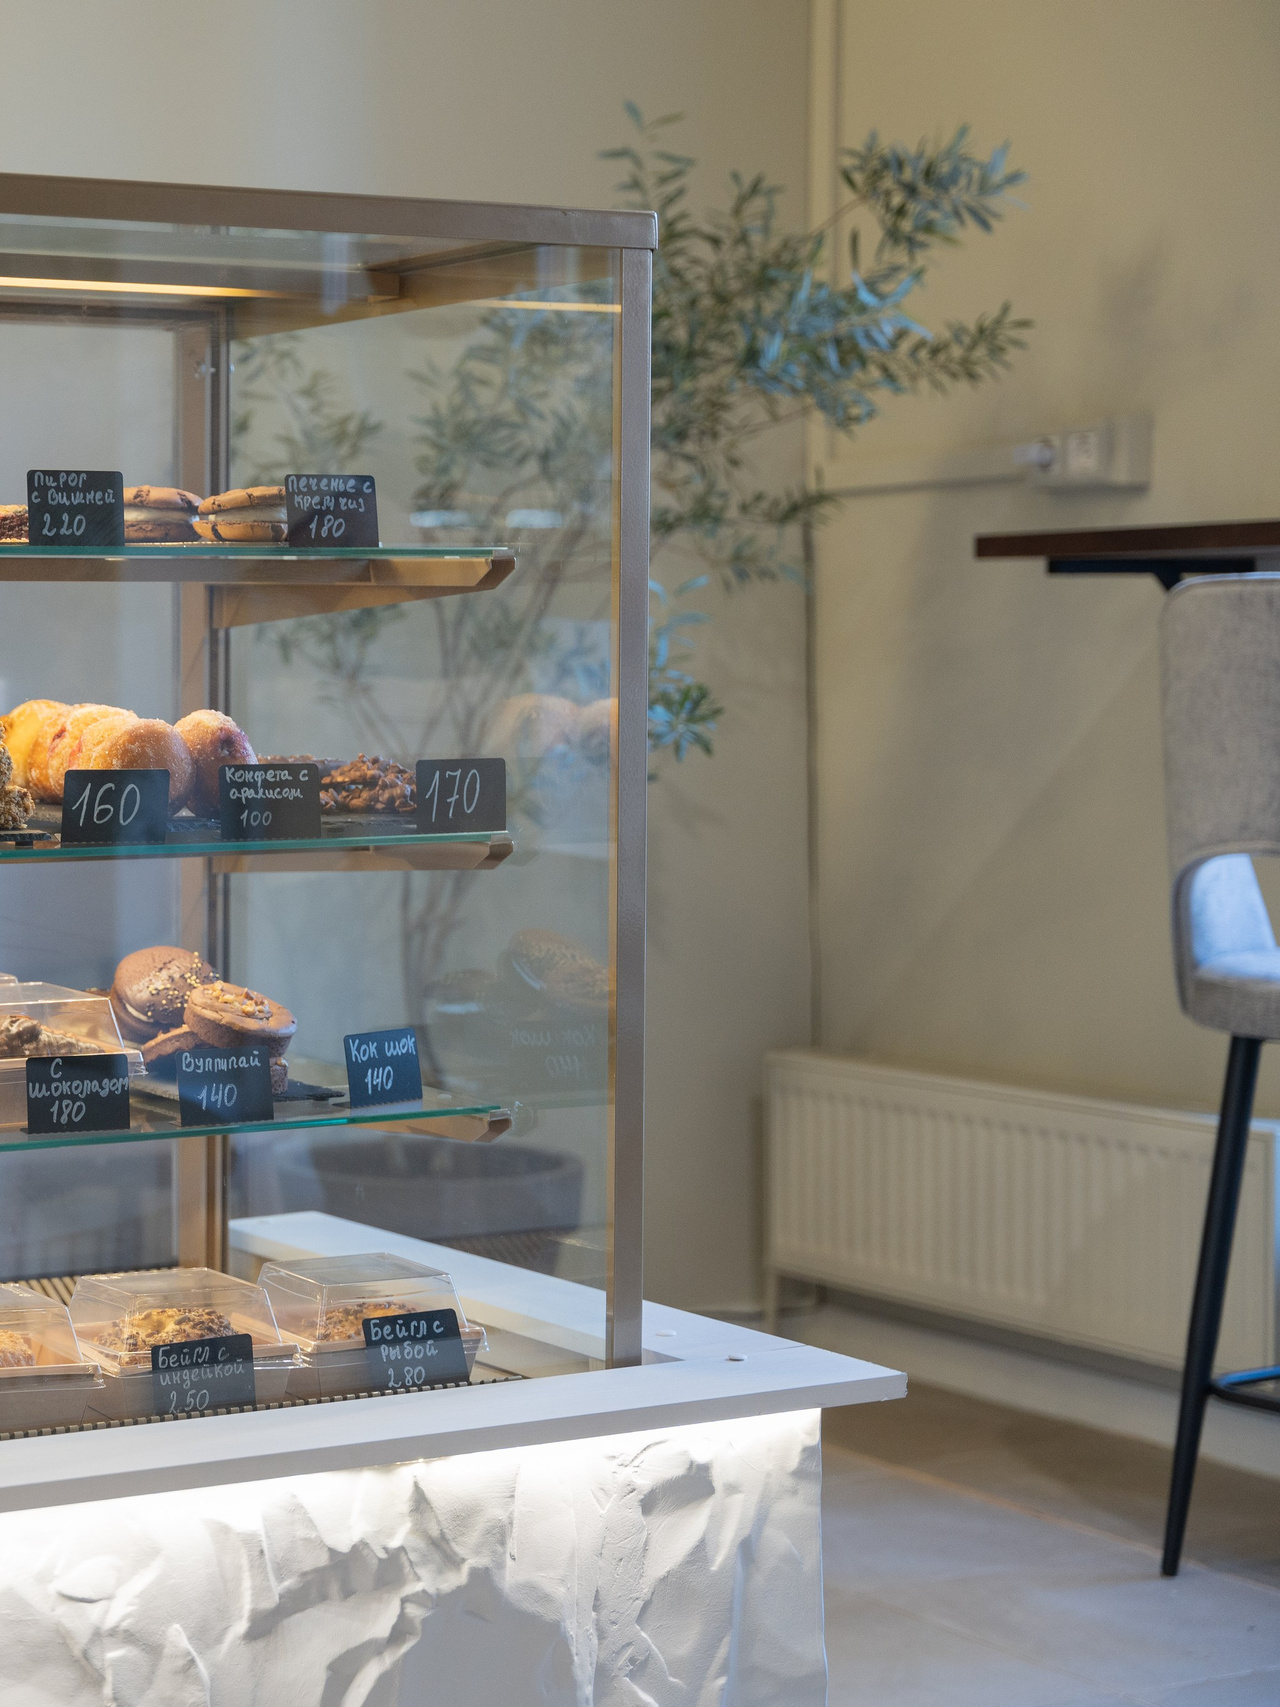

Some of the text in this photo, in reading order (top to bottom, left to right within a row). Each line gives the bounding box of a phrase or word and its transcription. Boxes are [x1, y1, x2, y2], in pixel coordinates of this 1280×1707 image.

[34, 471, 87, 488] Пирог
[288, 475, 356, 493] Печенье
[41, 513, 87, 537] 220
[309, 514, 346, 539] 180
[225, 767, 293, 786] Конфета
[71, 782, 141, 827] 160
[229, 787, 303, 805] арахисом
[425, 768, 480, 822] 170
[240, 809, 272, 828] 100
[349, 1034, 416, 1064] Кок шок
[365, 1065, 394, 1096] 140
[197, 1083, 237, 1111] 140
[49, 1099, 86, 1125] 180
[370, 1319, 427, 1341] Бейгл
[158, 1346, 210, 1369] Бейгл
[380, 1340, 439, 1363] рыбой
[159, 1358, 246, 1390] индейкой
[387, 1366, 426, 1388] 280
